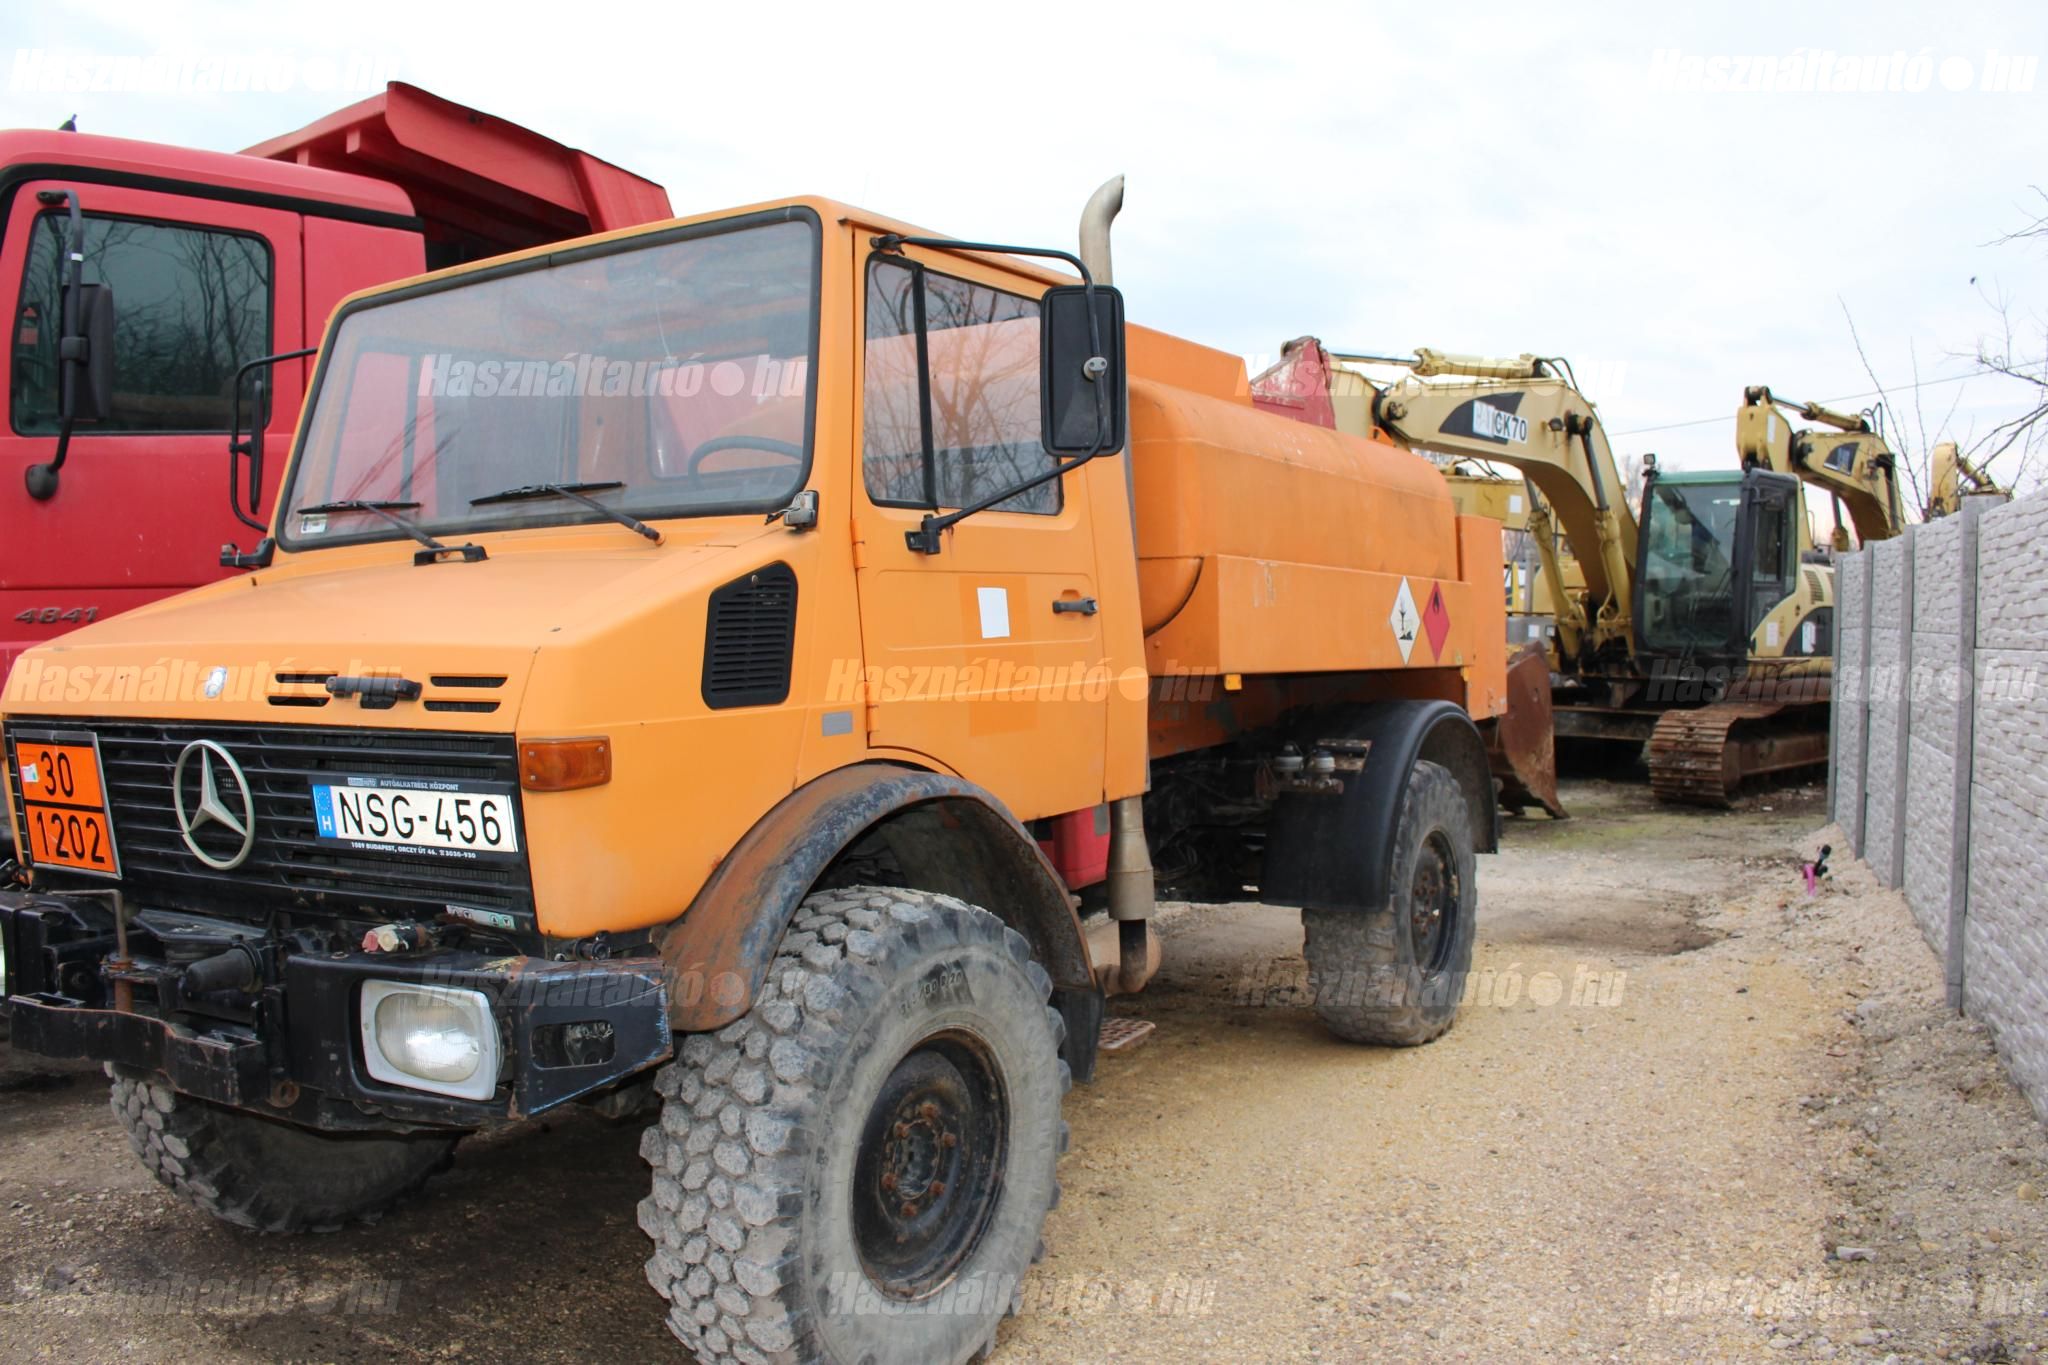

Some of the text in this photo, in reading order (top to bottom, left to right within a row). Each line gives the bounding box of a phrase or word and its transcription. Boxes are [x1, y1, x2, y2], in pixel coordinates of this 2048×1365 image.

[14, 606, 99, 625] 4841
[40, 750, 74, 798] 30
[36, 811, 105, 864] 1202
[321, 815, 333, 832] H
[338, 791, 502, 846] NSG-456
